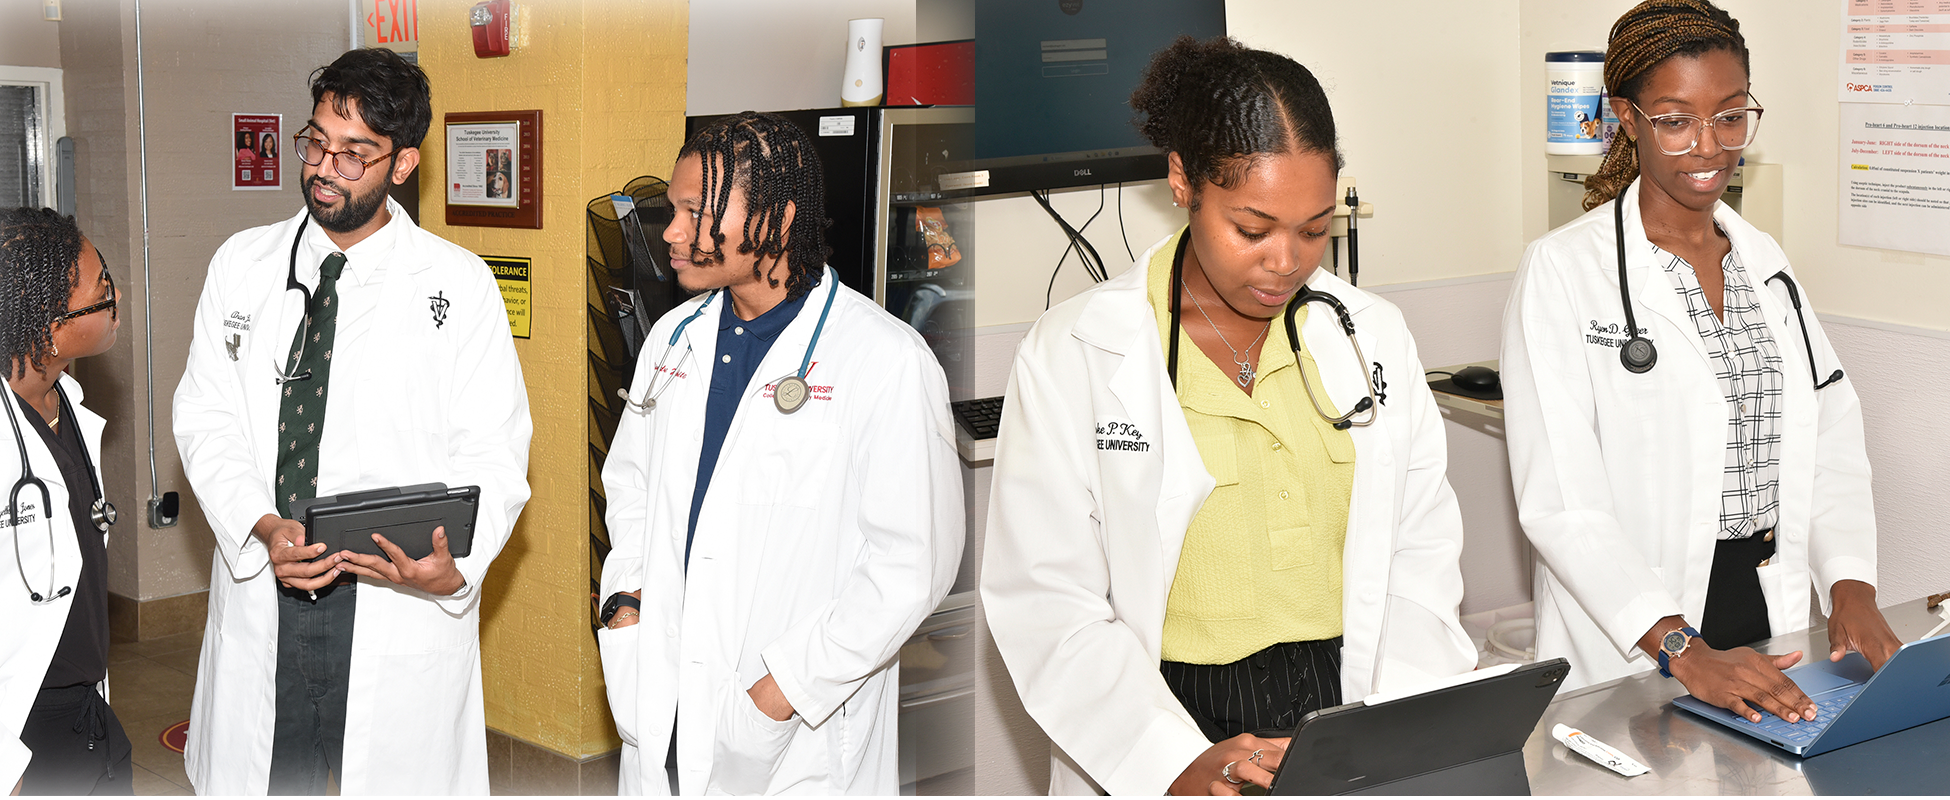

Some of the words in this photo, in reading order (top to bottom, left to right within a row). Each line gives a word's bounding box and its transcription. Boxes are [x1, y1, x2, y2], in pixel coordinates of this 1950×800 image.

[509, 286, 528, 294] threats,
[1609, 323, 1621, 334] D.
[1586, 334, 1614, 347] TUSKEGEE
[1106, 422, 1118, 435] P.
[1106, 439, 1150, 452] UNIVERSITY
